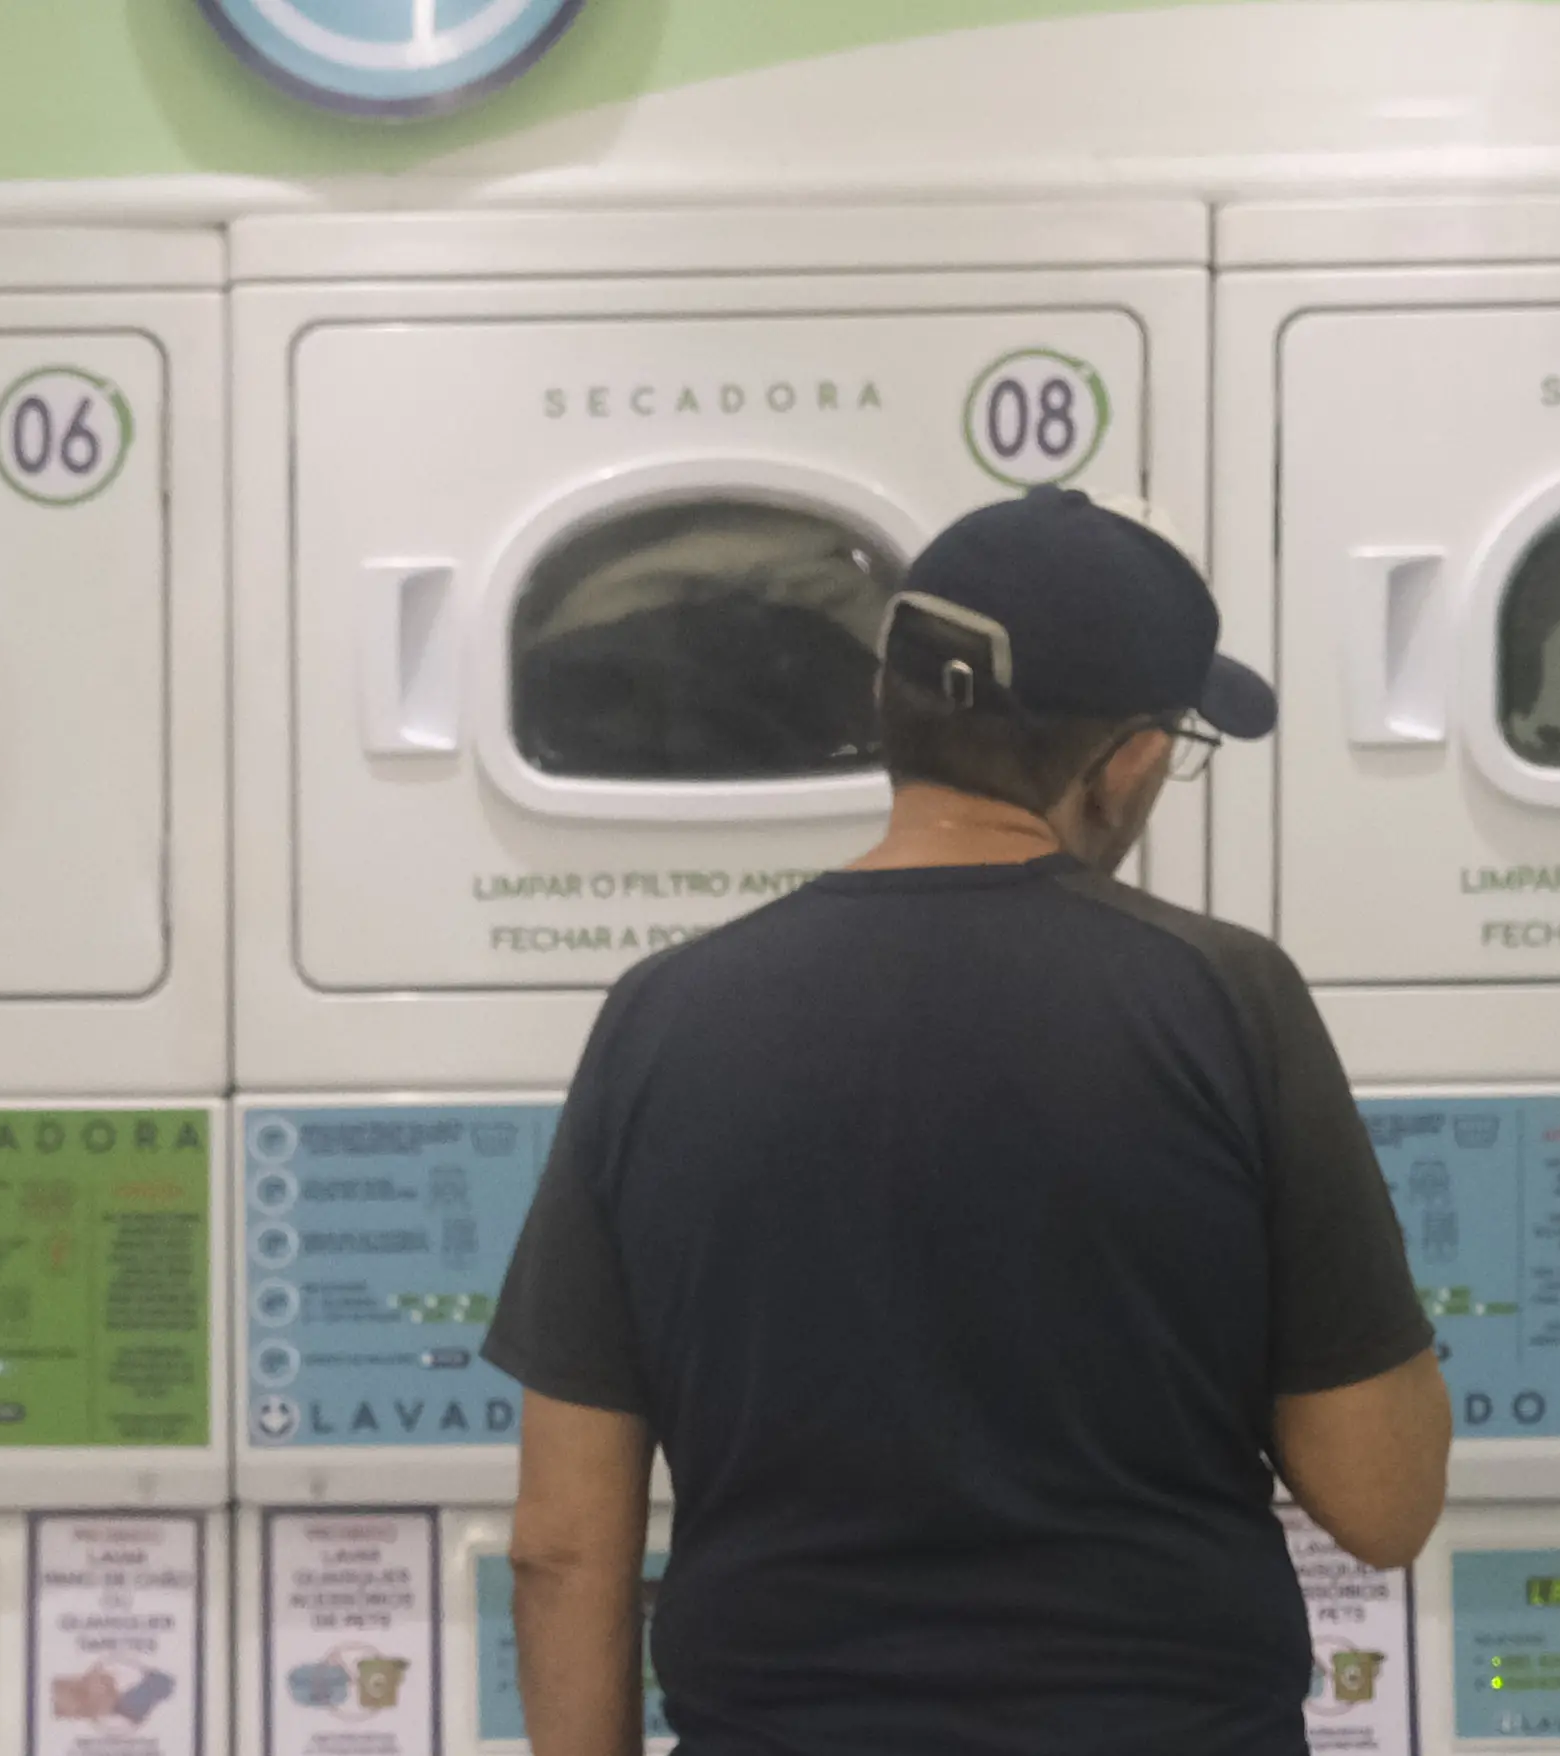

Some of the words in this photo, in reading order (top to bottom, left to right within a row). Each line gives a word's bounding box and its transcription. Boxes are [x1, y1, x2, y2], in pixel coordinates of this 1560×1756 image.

[544, 381, 885, 418] SECADORA
[10, 394, 102, 475] 06
[986, 378, 1077, 459] 08
[472, 872, 584, 903] LIMPAR
[591, 871, 616, 900] O
[622, 868, 730, 900] FILTRO
[491, 926, 612, 954] FECHAR
[618, 924, 642, 951] A
[308, 1398, 516, 1435] LAVAD
